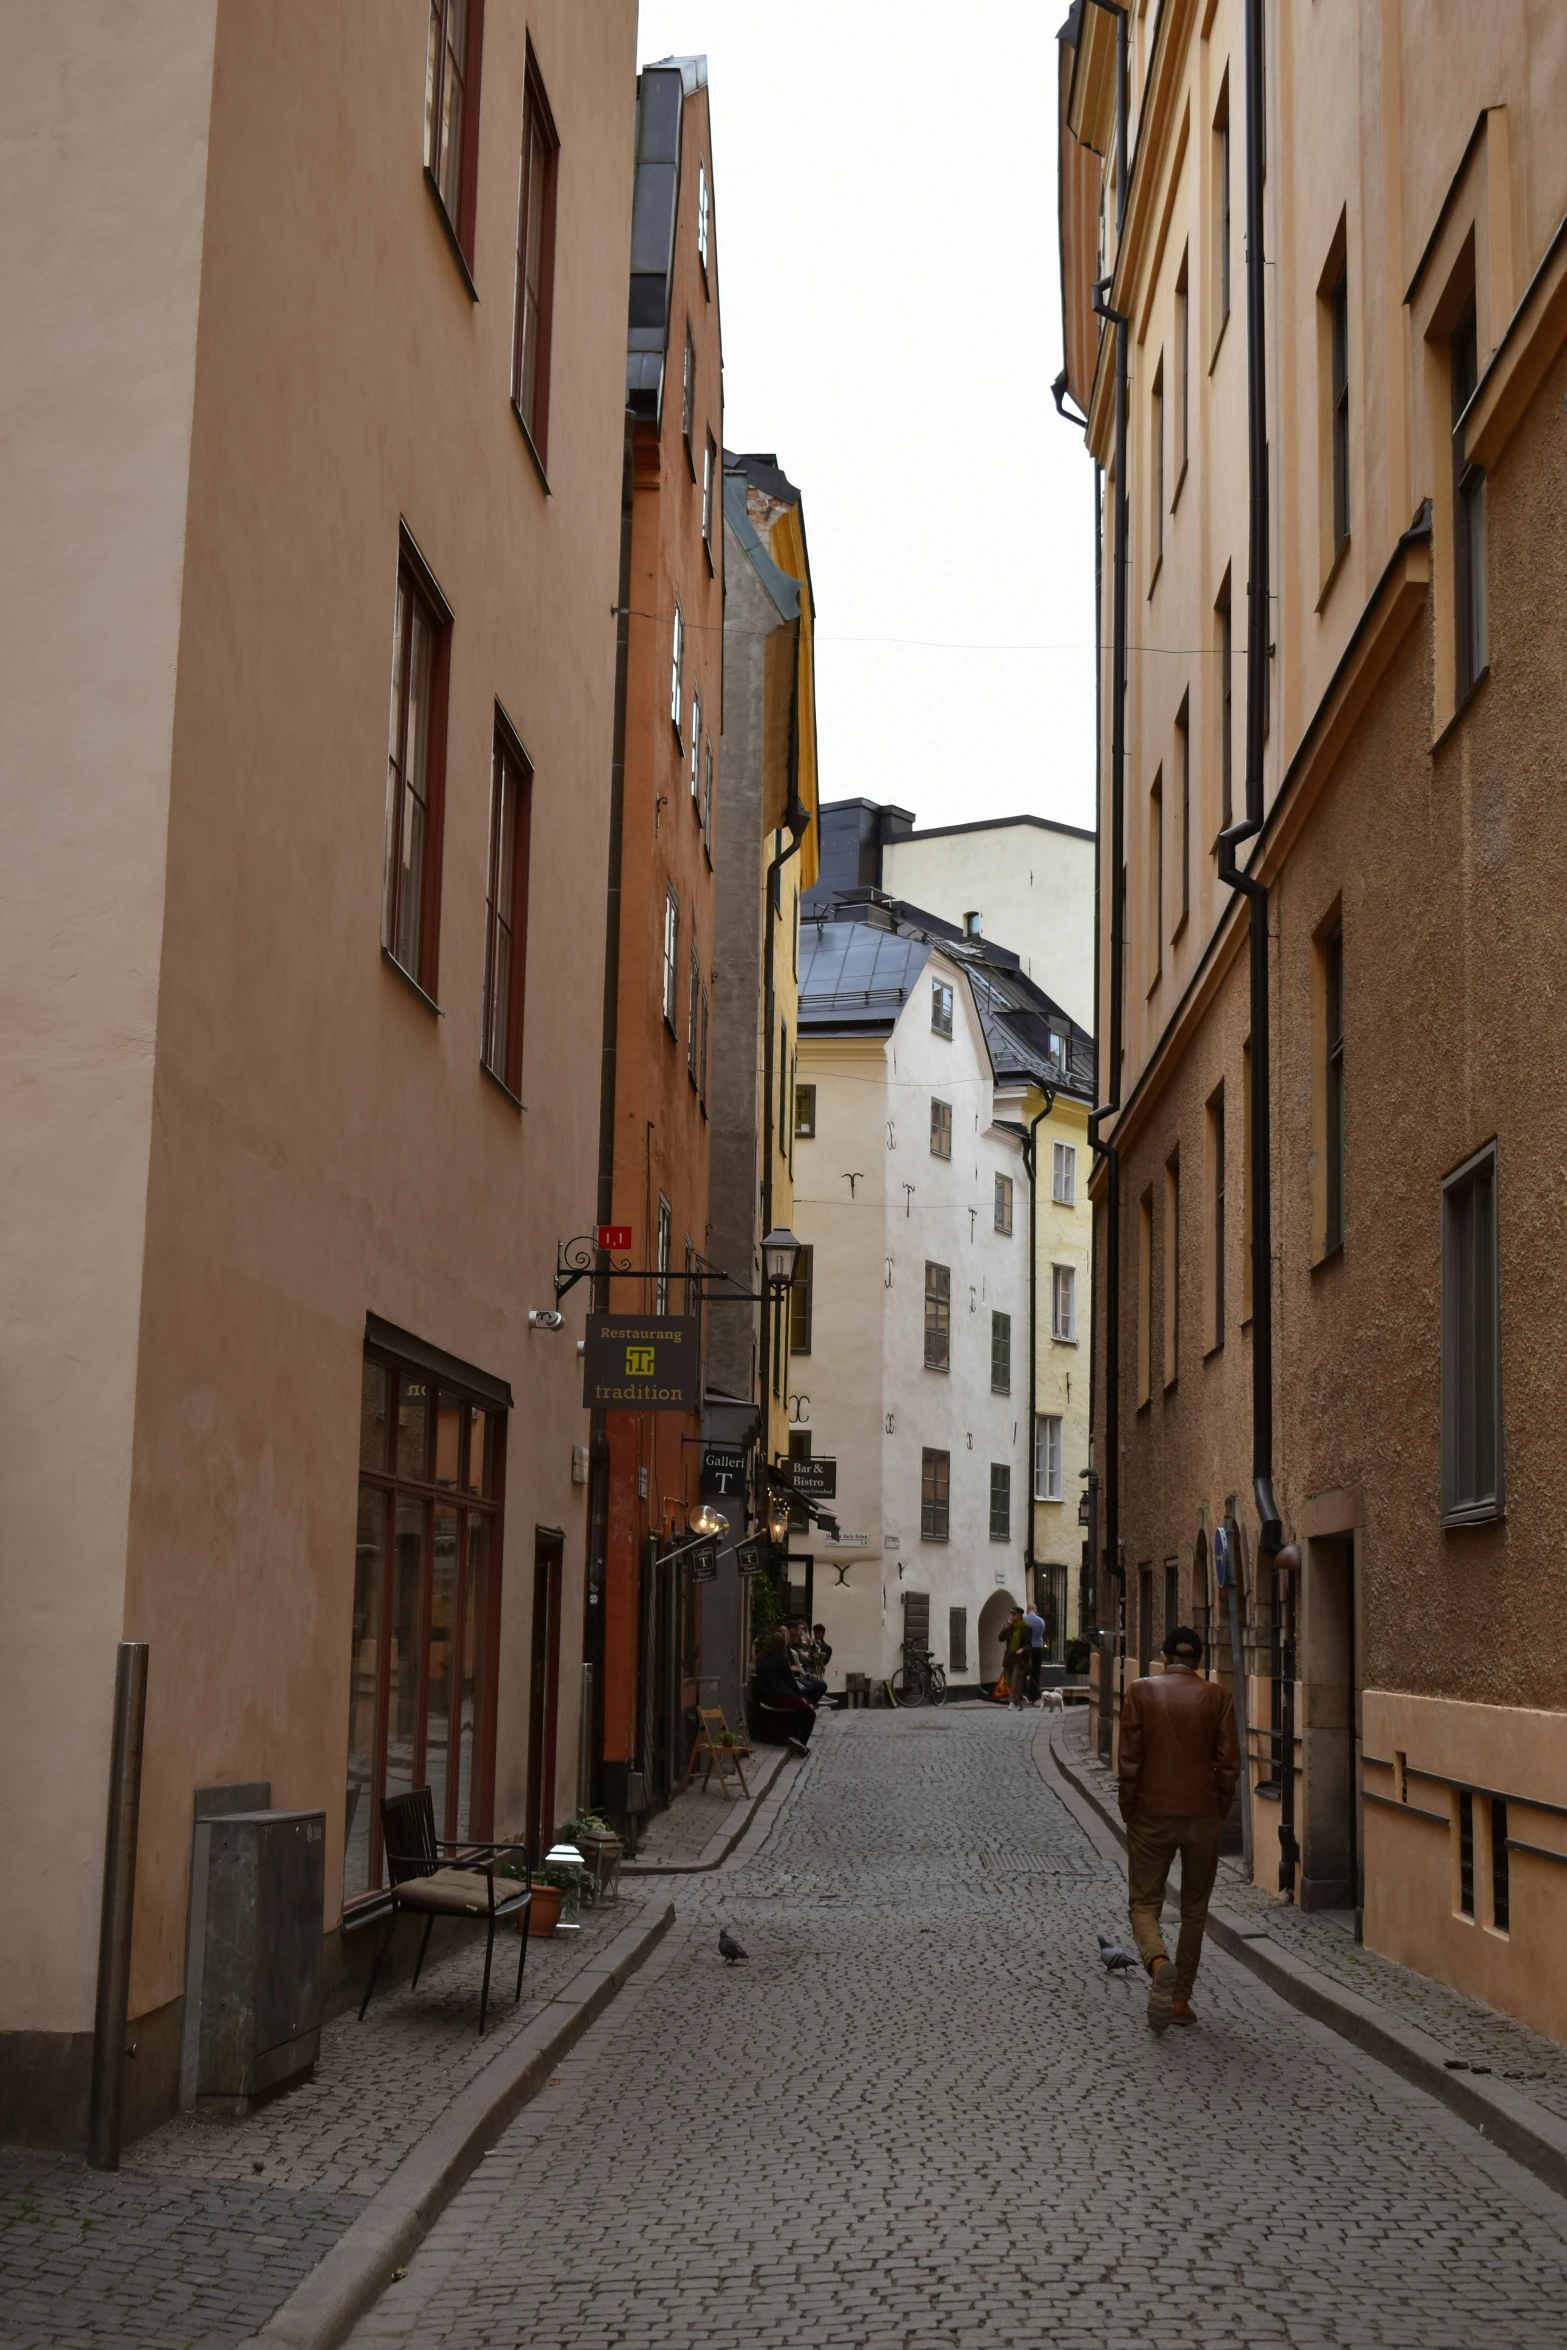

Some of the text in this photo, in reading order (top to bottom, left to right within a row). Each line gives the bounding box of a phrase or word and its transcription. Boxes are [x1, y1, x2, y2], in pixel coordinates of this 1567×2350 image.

[601, 1327, 683, 1343] Restaurang
[596, 1384, 683, 1401] tradition
[705, 1454, 745, 1468] Galleri
[793, 1463, 824, 1473] Bar &
[715, 1473, 732, 1494] T
[793, 1476, 823, 1487] Bistro
[699, 1557, 708, 1567] T
[744, 1555, 752, 1563] T
